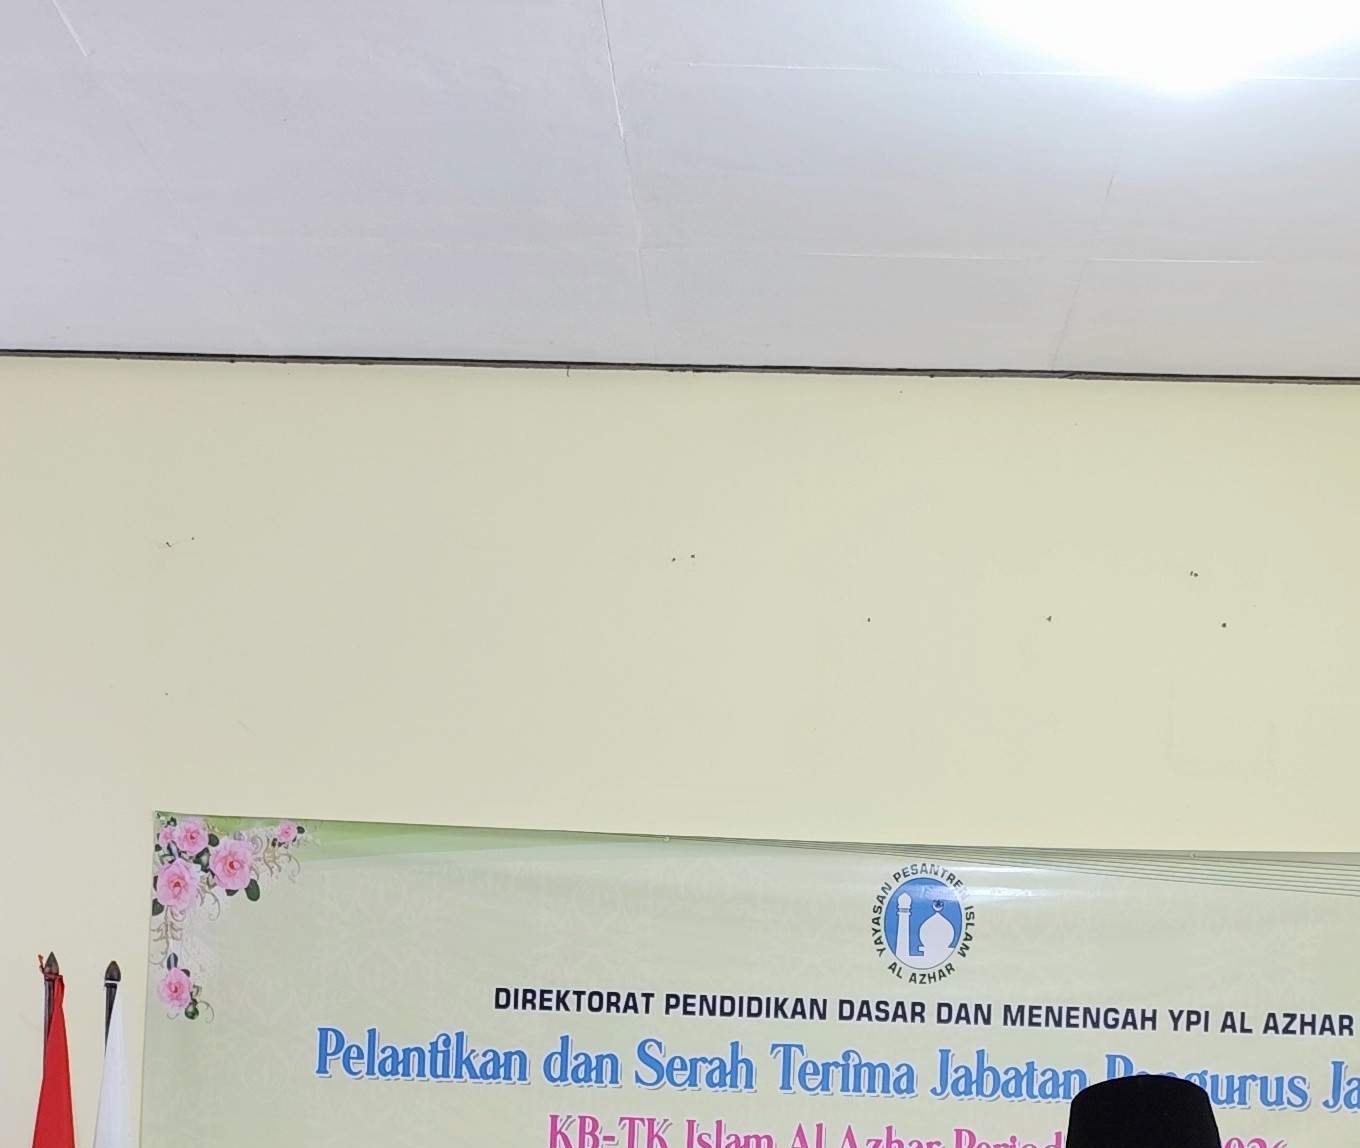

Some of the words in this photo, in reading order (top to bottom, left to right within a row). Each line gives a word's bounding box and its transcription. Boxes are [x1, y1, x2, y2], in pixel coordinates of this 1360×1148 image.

[871, 882, 893, 958] YAYASAN
[957, 905, 976, 958] ISLAM
[888, 961, 903, 979] AL
[908, 962, 956, 985] AZHAR
[494, 987, 655, 1016] DIREKTORAT
[665, 993, 828, 1021] PENDIDIKAN
[838, 998, 926, 1025] DASAR
[935, 1002, 992, 1027] DAN
[1002, 1004, 1158, 1032] MENENGAH
[1167, 1009, 1211, 1033] YPI
[1220, 1011, 1254, 1035] AL
[1262, 1013, 1355, 1037] AZHAR
[315, 1027, 529, 1083] Pelantikan
[542, 1035, 621, 1085] dan
[634, 1038, 757, 1091] Serah
[770, 1043, 917, 1097] Terima
[929, 1048, 1088, 1101] Jabatan
